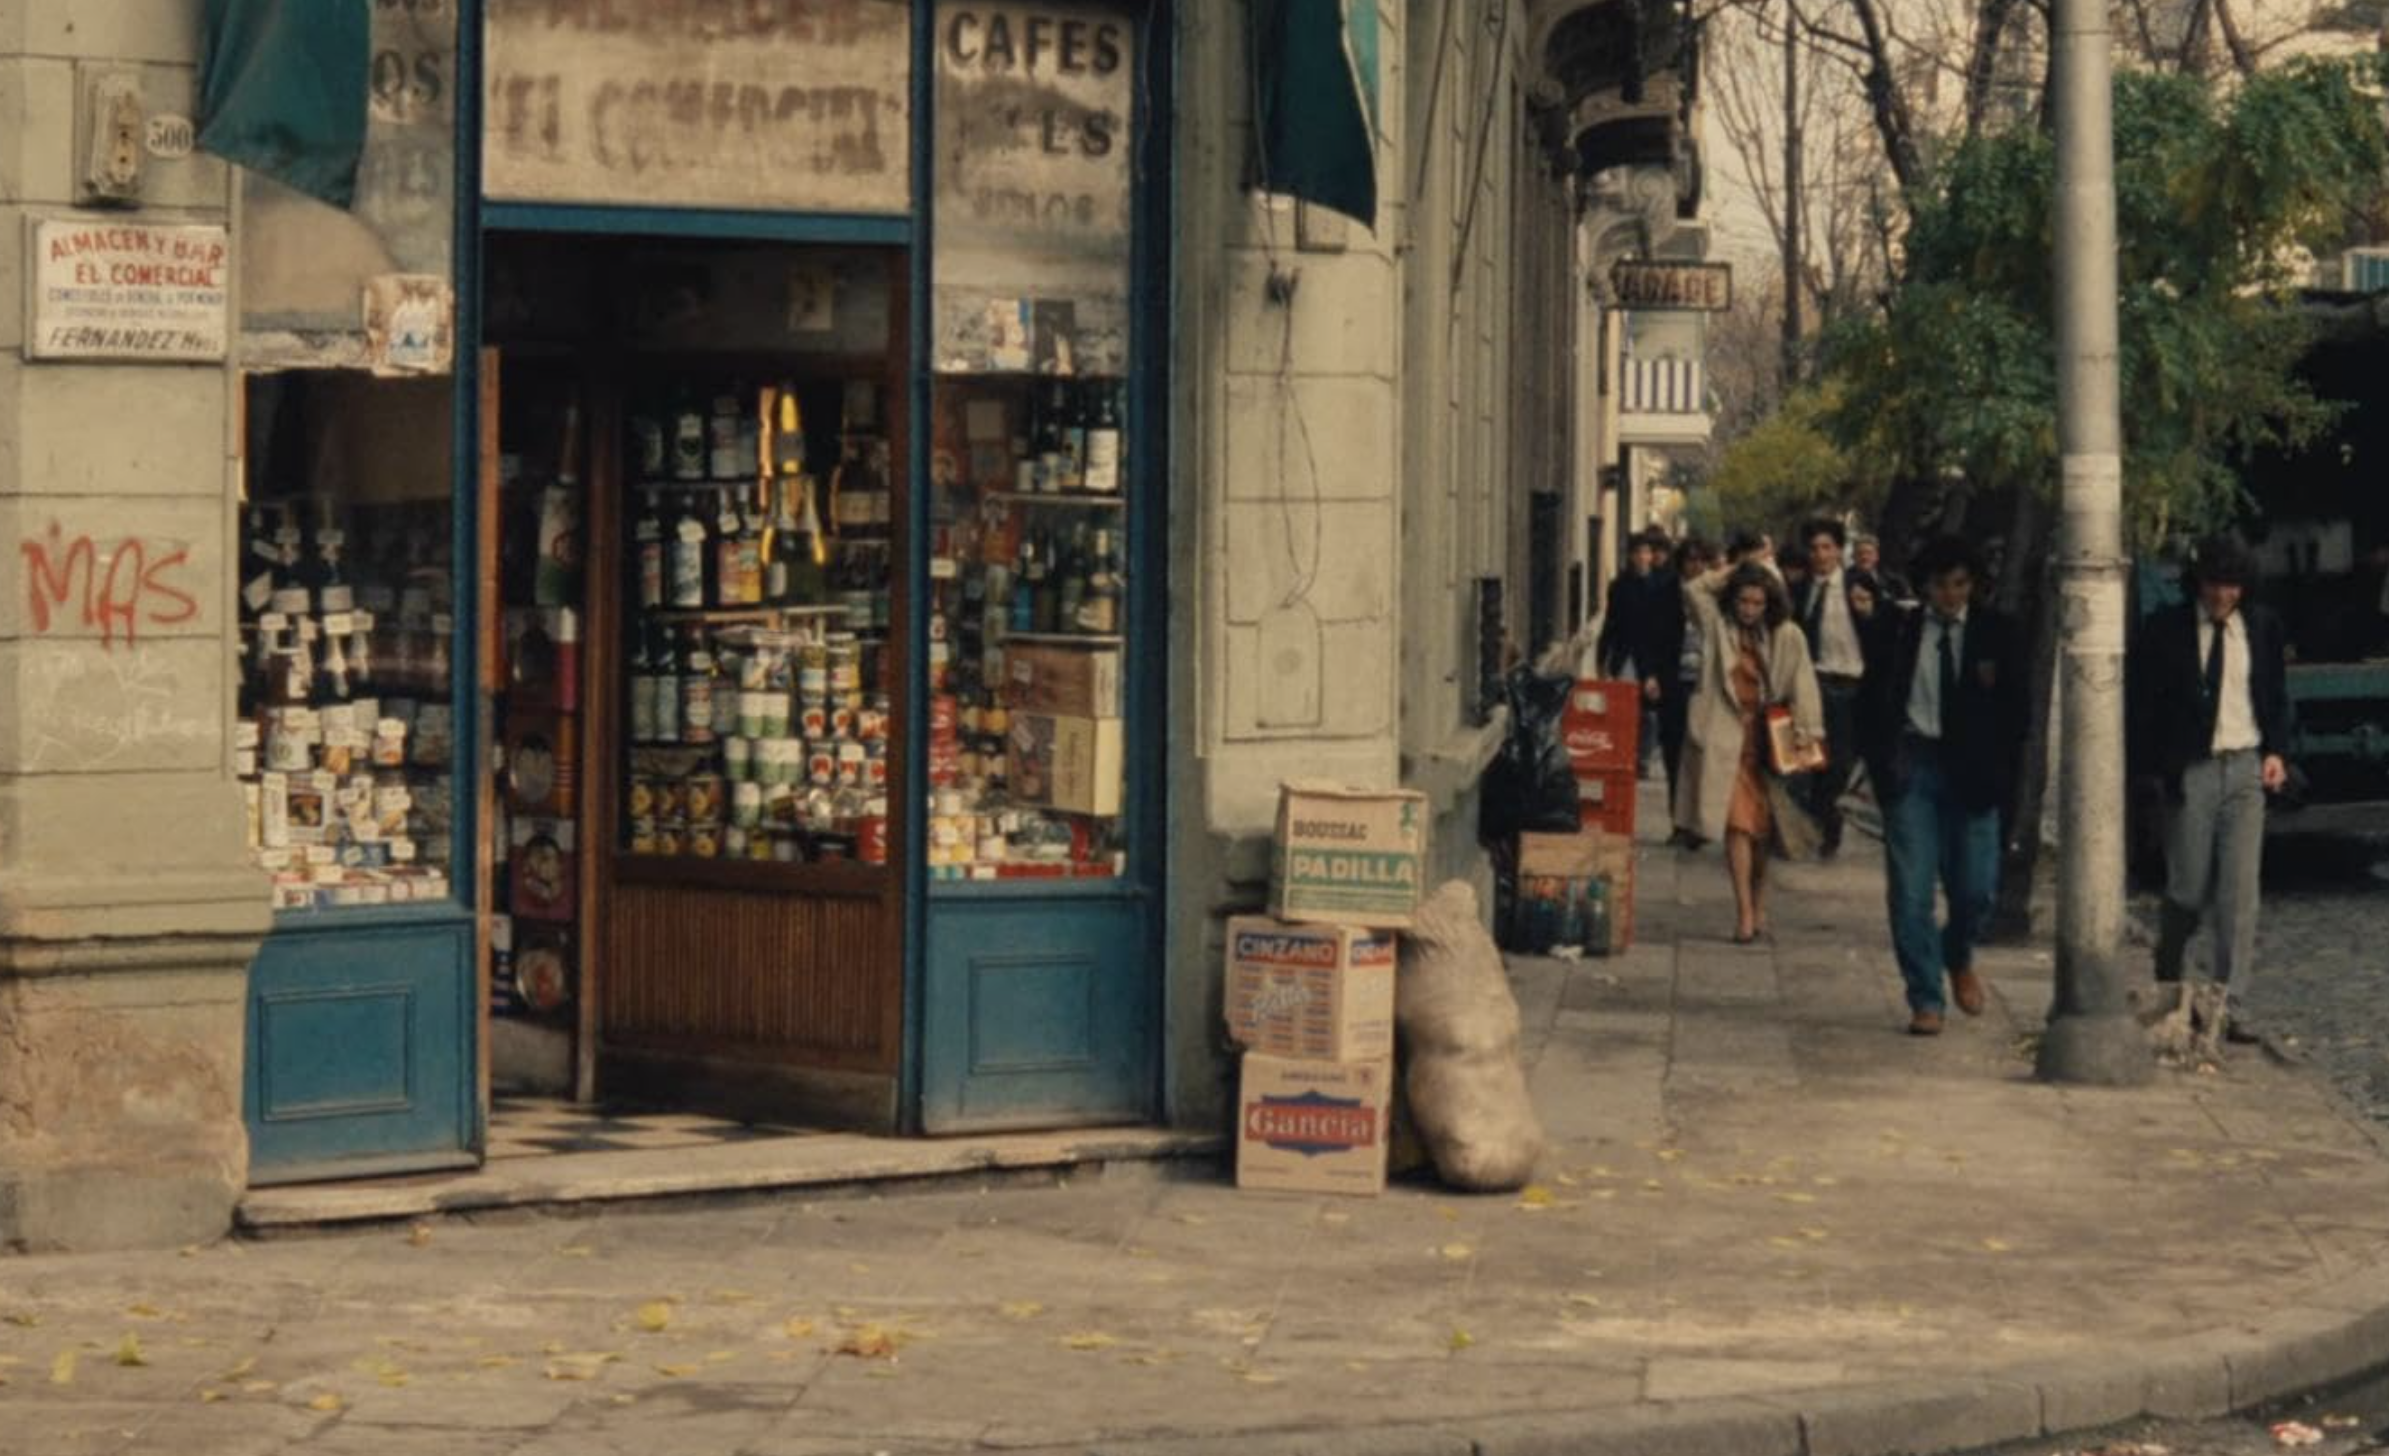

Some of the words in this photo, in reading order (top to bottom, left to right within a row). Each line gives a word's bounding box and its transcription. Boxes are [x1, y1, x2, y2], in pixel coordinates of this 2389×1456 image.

[948, 12, 1119, 76] CAFES
[51, 229, 149, 262] ALMACEN
[155, 236, 166, 255] Y
[75, 263, 101, 284] EL
[110, 264, 215, 287] COMERCIAL
[50, 326, 175, 349] FERNANDEZ
[20, 534, 198, 651] MAS
[1292, 855, 1414, 883] PADILLA
[1238, 936, 1334, 964] CINZANO
[1249, 1107, 1370, 1140] Gancia
